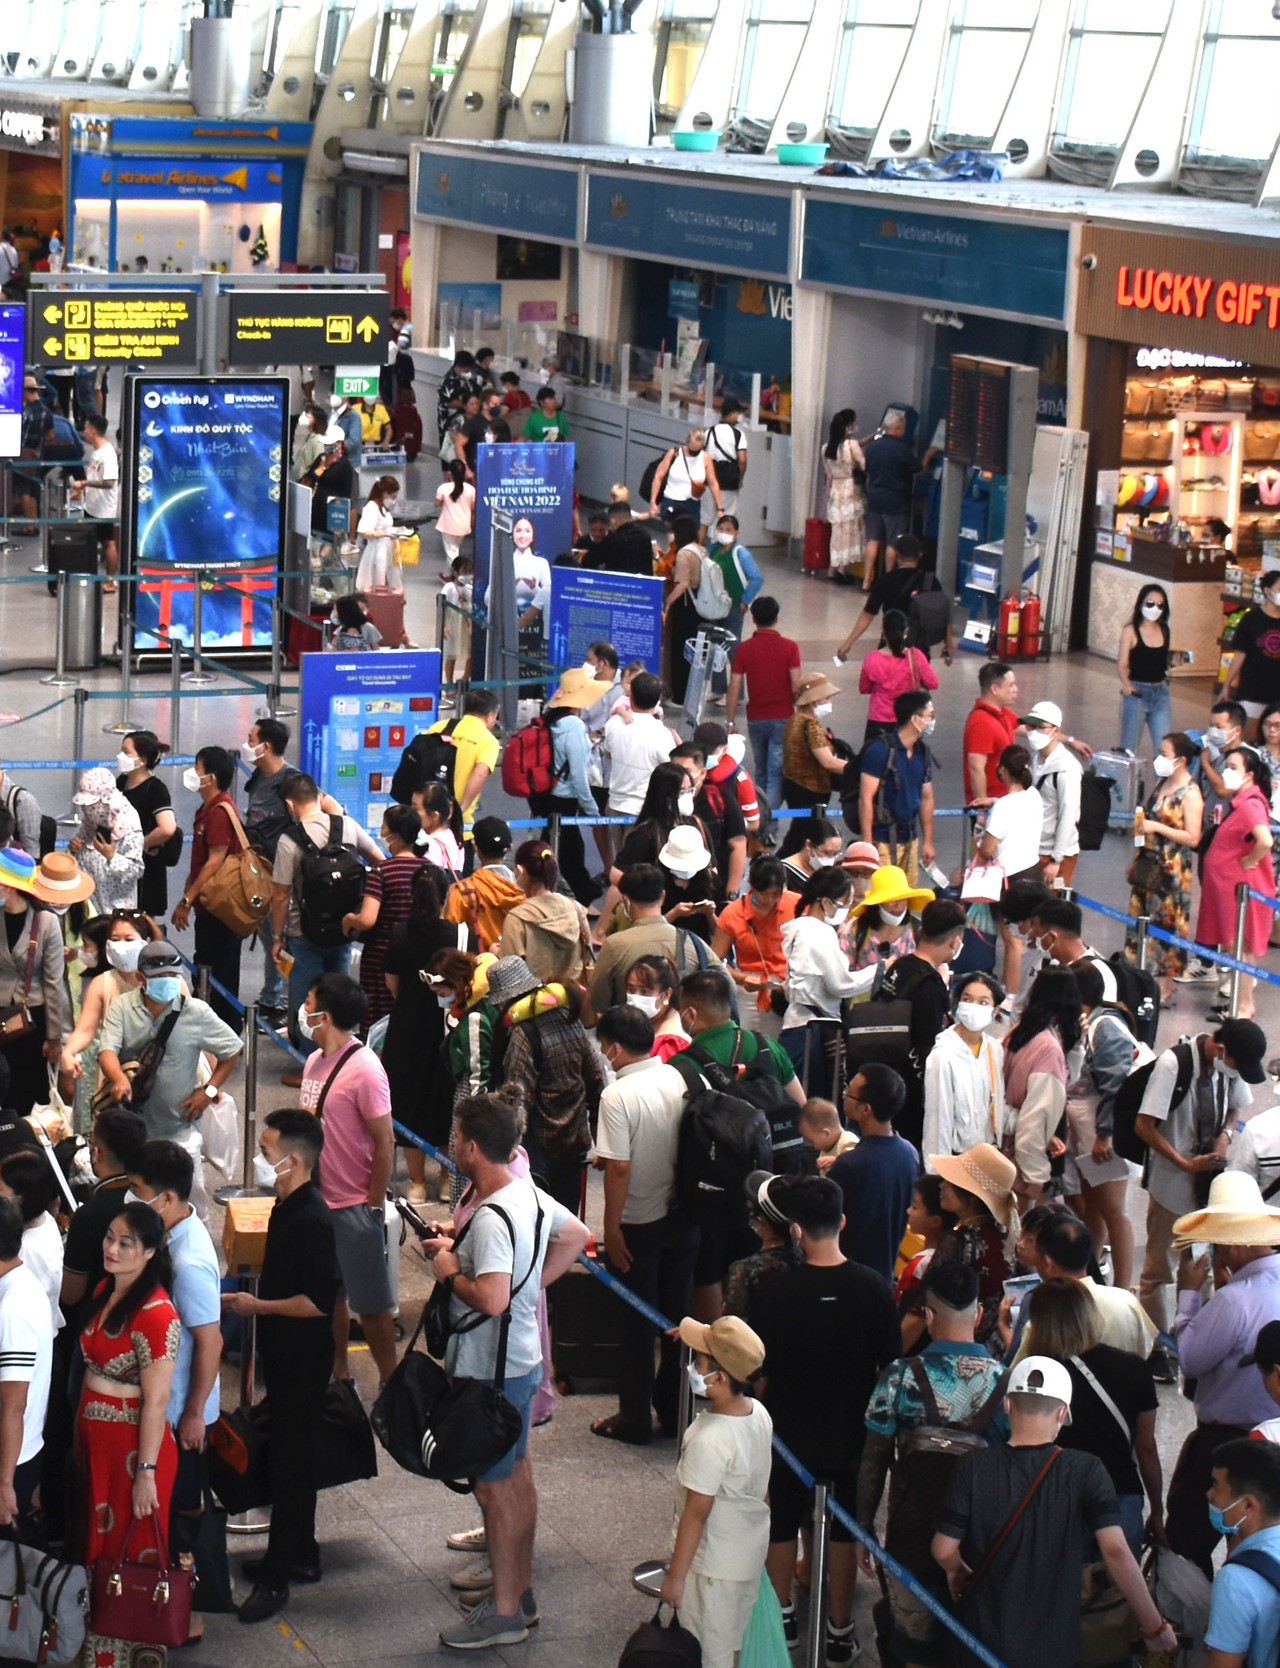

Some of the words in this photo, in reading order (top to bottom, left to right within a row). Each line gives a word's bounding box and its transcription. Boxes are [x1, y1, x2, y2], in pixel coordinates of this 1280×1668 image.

[1116, 265, 1213, 319] LUCKY
[343, 379, 362, 393] EXIT
[193, 395, 209, 407] Fuji
[235, 395, 275, 403] WYNDHAM
[170, 425, 194, 433] KINH
[509, 496, 533, 506] NAM
[535, 495, 561, 506] 2022
